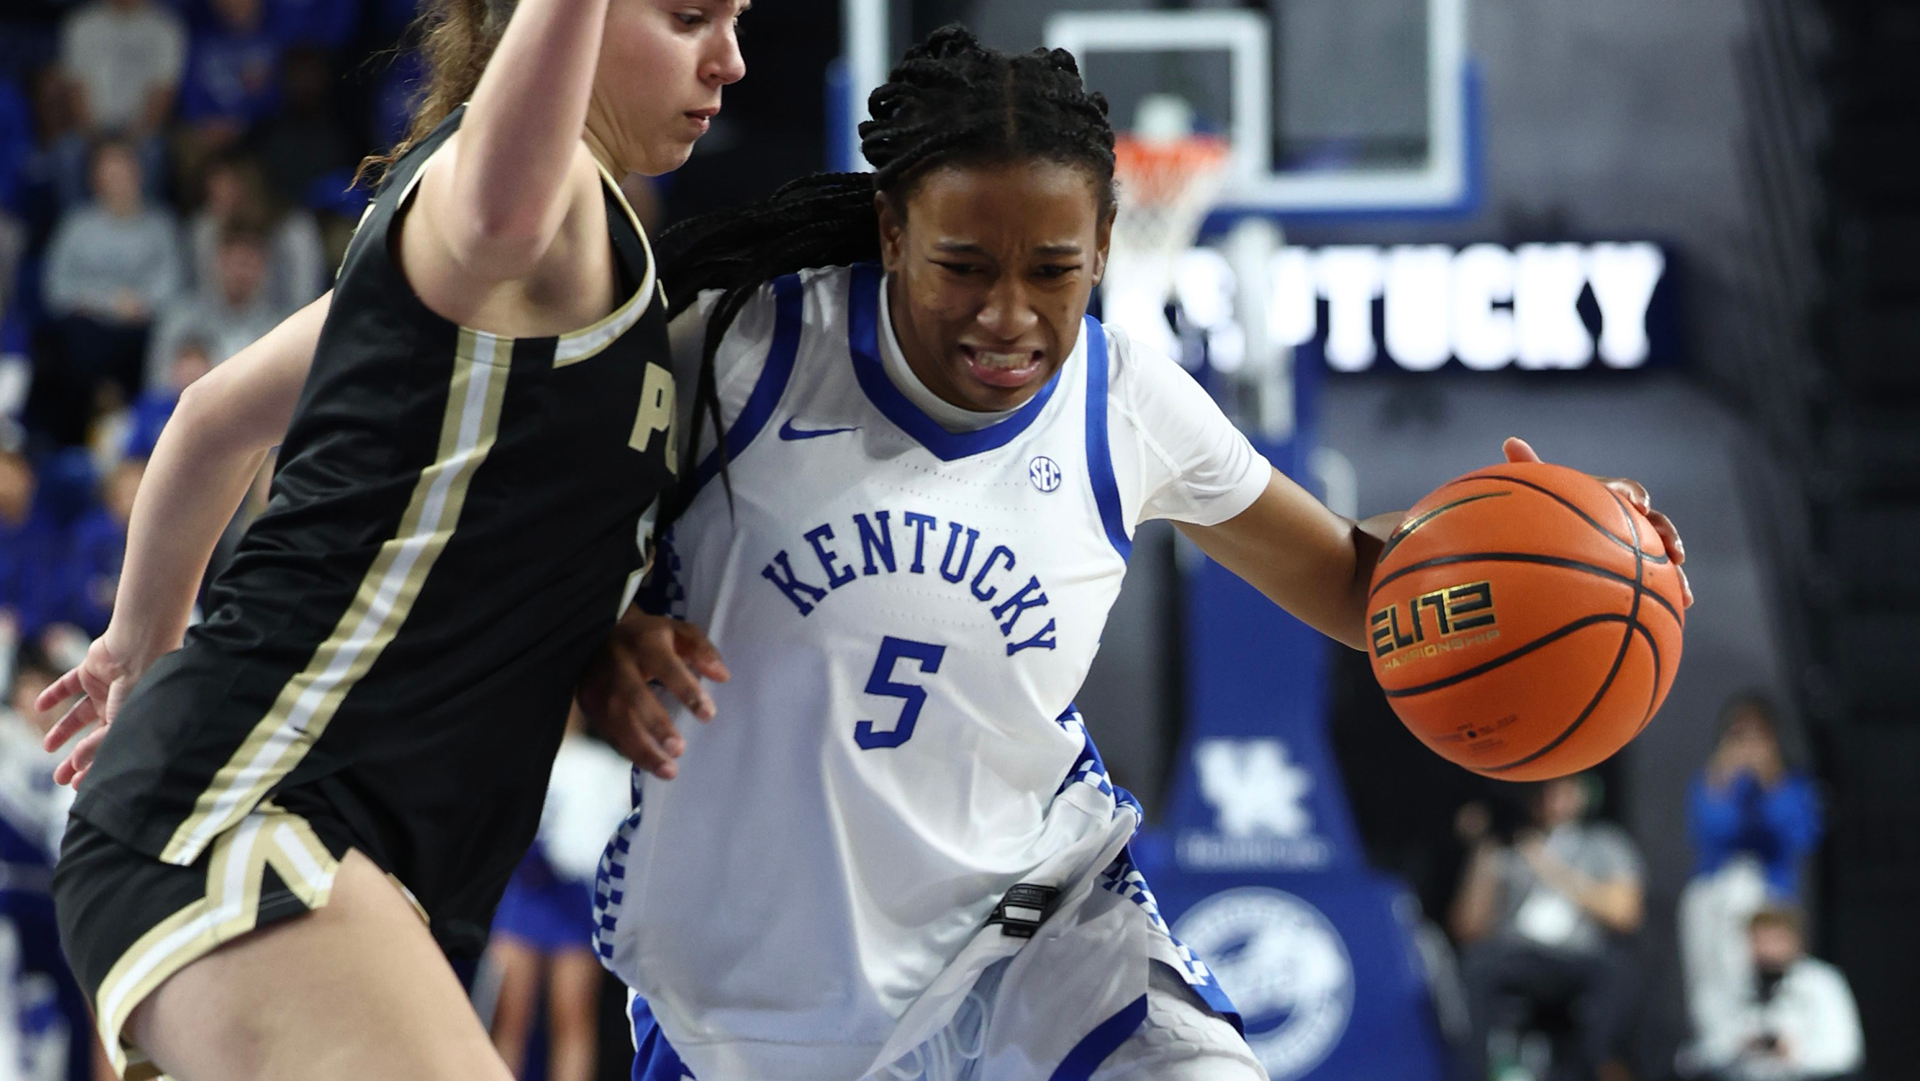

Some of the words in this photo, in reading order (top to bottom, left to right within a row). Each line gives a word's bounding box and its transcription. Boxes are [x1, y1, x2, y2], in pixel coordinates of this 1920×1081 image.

[1029, 456, 1061, 492] SEC
[761, 510, 1056, 656] KENTUCKY
[1371, 580, 1495, 658] ELITE
[1382, 629, 1500, 672] HAMPIONSHIP
[853, 635, 947, 750] 5
